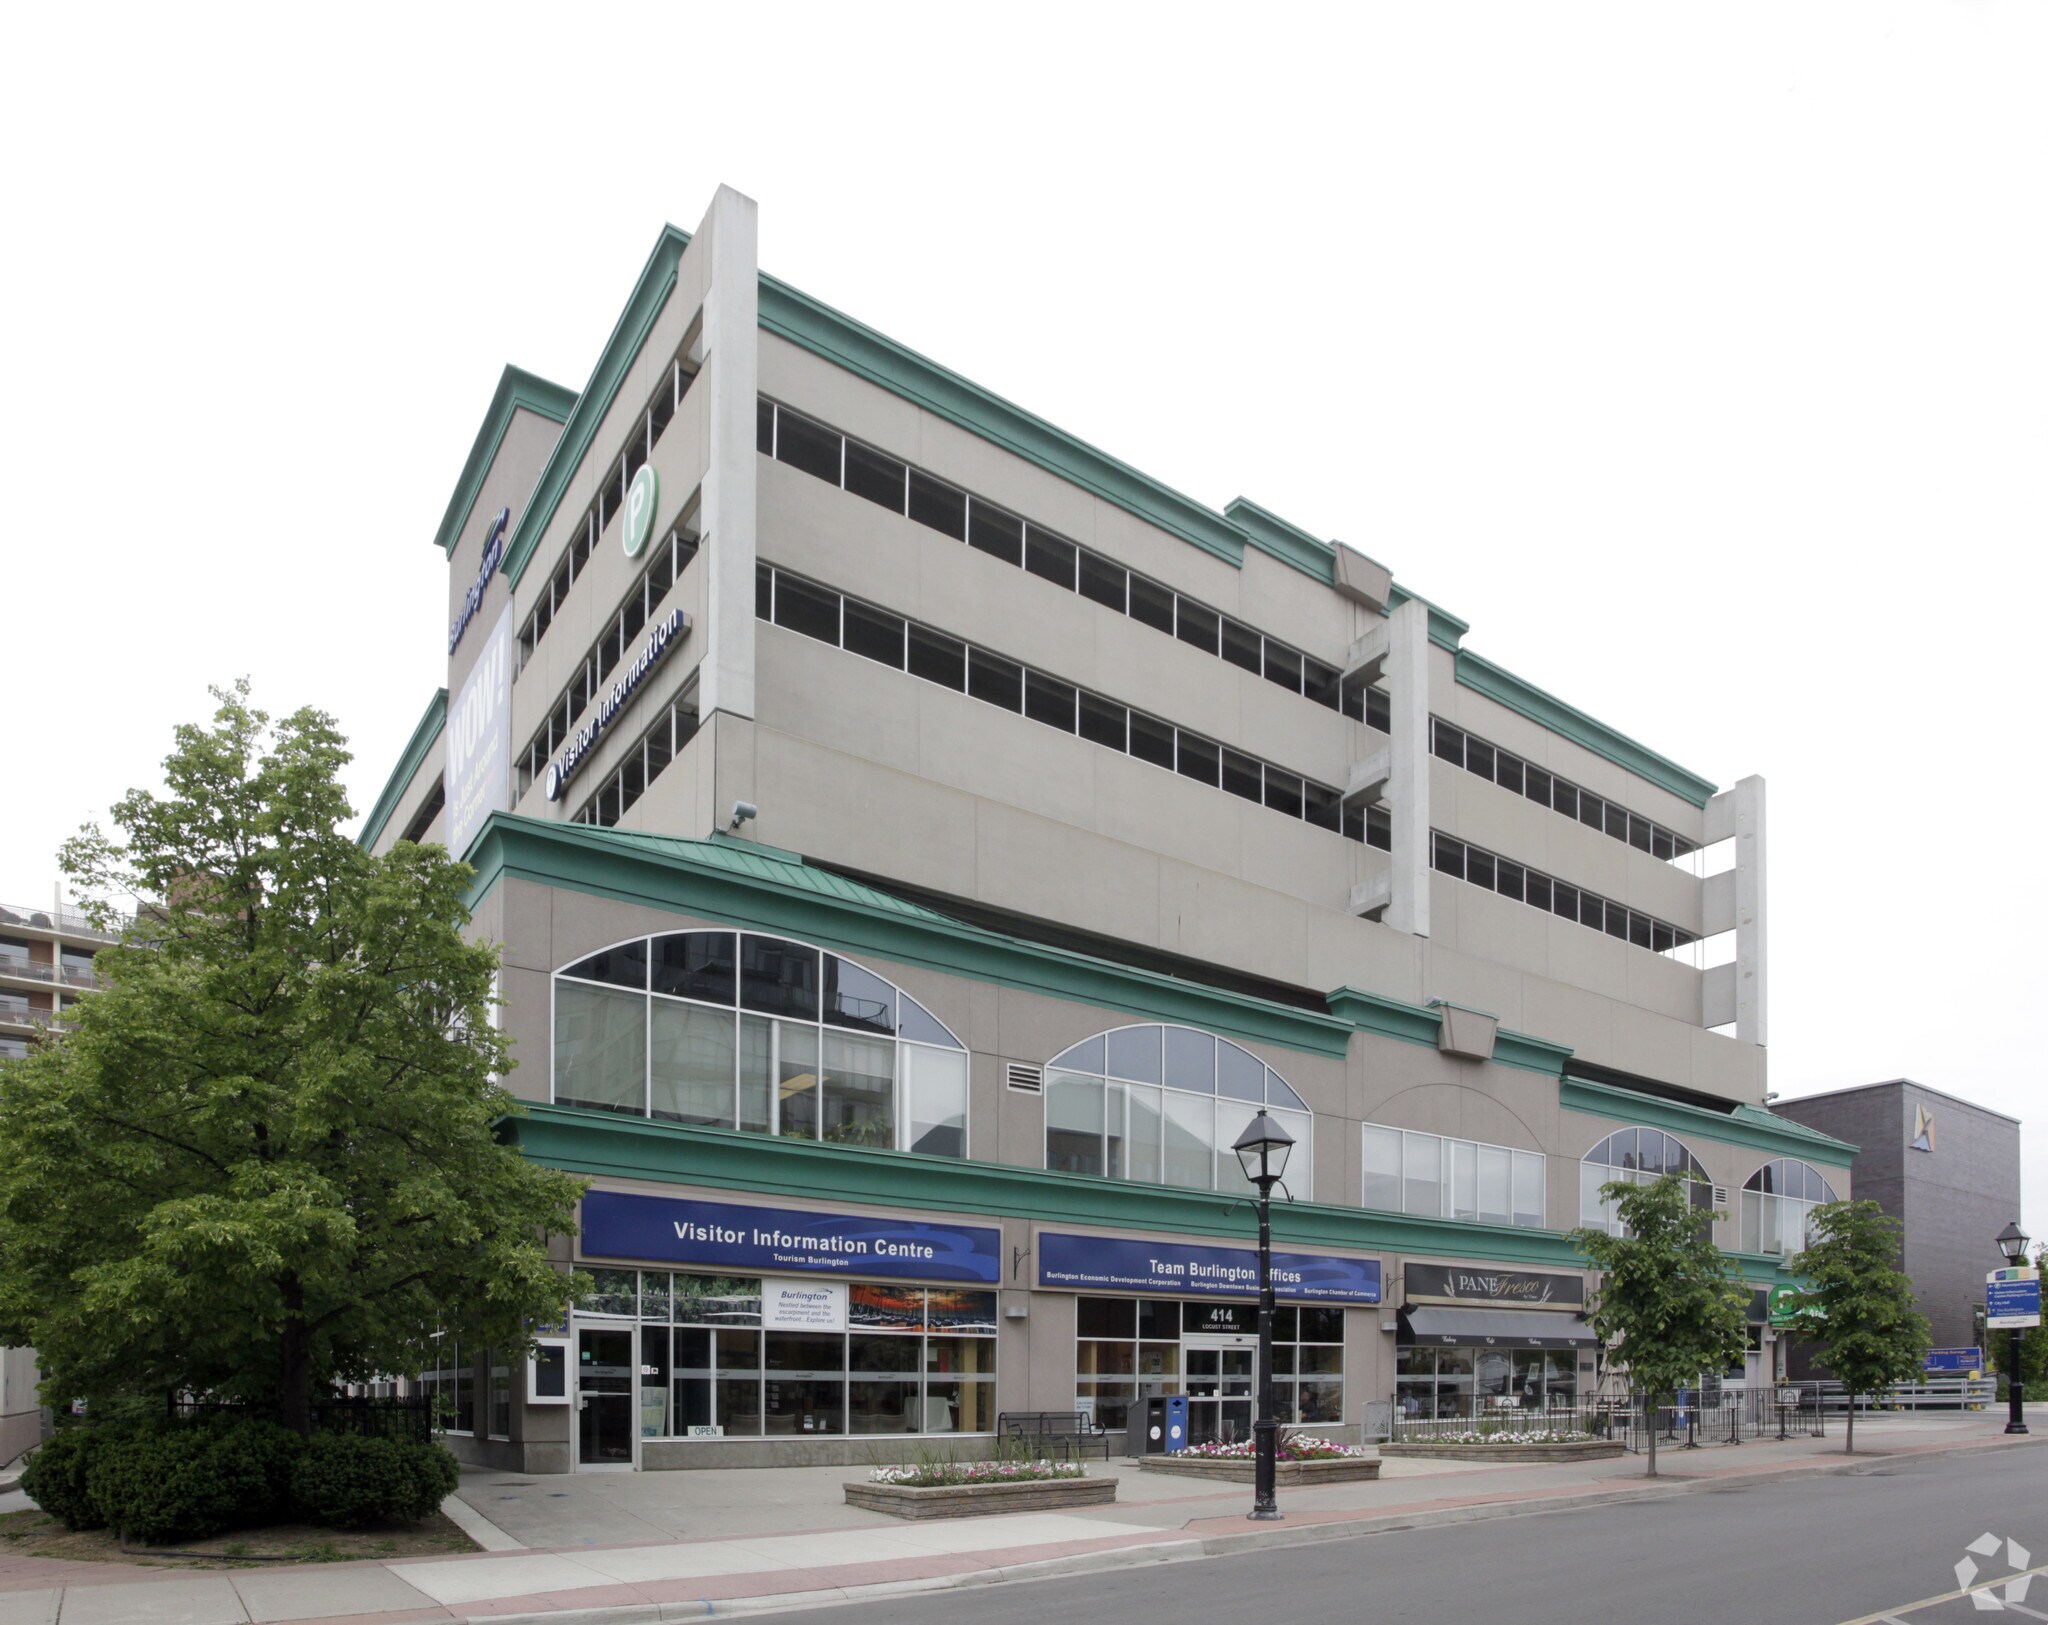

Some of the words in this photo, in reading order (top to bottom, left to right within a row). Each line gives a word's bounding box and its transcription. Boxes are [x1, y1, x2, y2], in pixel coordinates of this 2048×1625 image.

[630, 481, 645, 541] P
[557, 717, 599, 779] Visitor
[599, 608, 683, 728] Information
[449, 633, 505, 787] WOW!
[674, 1221, 746, 1244] Visitor
[753, 1228, 867, 1254] Information
[874, 1238, 934, 1259] Centre
[773, 1253, 805, 1263] Tourism
[807, 1255, 849, 1266] Burlington
[1150, 1259, 1184, 1275] Team
[1190, 1262, 1256, 1282] Burlington
[1269, 1268, 1301, 1283] ffices
[1046, 1271, 1079, 1281] Burlington
[1080, 1273, 1109, 1282] Economic
[1110, 1275, 1148, 1285] Development
[1148, 1278, 1181, 1287] Corporation
[1190, 1281, 1218, 1290] Burlington
[1459, 1275, 1498, 1292] PANE
[781, 1290, 828, 1302] Burlington
[1304, 1287, 1328, 1296] Burlington
[1354, 1290, 1377, 1298] Commerce
[1210, 1308, 1233, 1323] 414
[1202, 1323, 1221, 1331] LOCUST
[694, 1426, 717, 1436] OPEN
